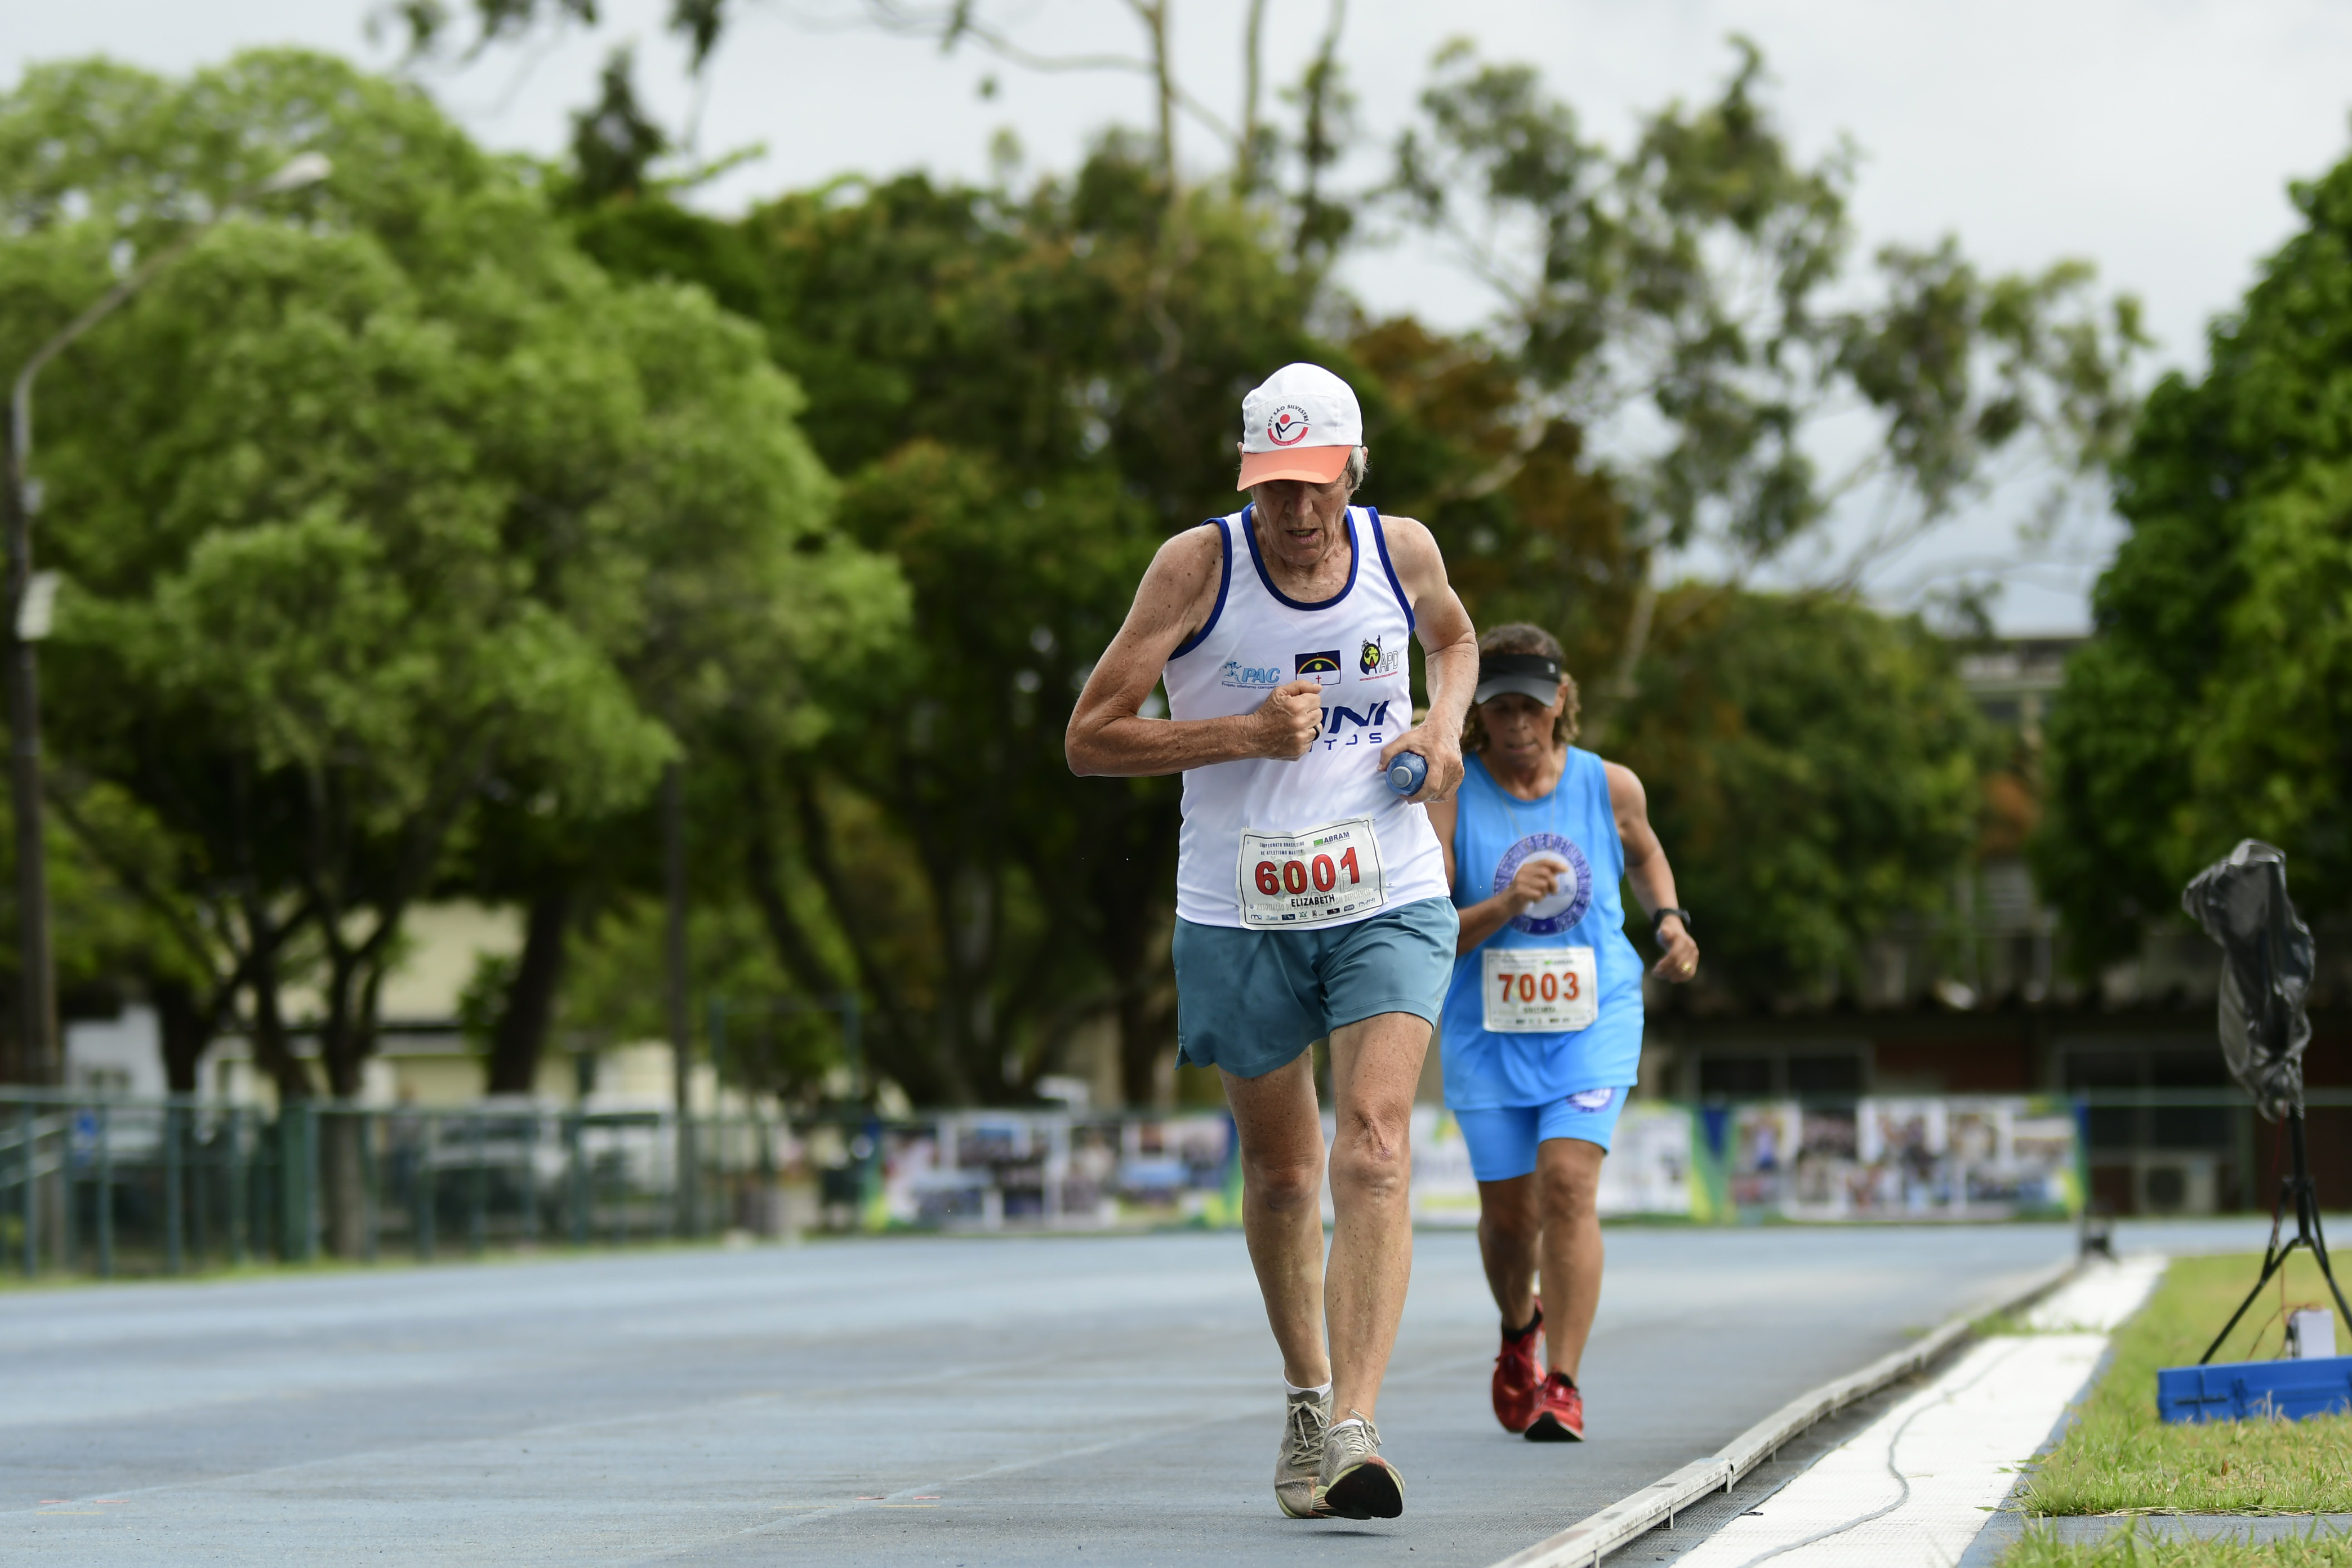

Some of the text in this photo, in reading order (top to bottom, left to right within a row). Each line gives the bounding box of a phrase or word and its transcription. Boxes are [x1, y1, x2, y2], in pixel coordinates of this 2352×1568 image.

[1273, 406, 1285, 416] SÃO
[1287, 404, 1309, 422] SILVESTRE
[1379, 651, 1398, 673] APD
[1241, 668, 1281, 683] PAC
[1324, 831, 1350, 844] ABRAM
[1255, 847, 1360, 896] 6001
[1291, 893, 1335, 907] ELIZABETH
[1498, 972, 1580, 1003] 7003
